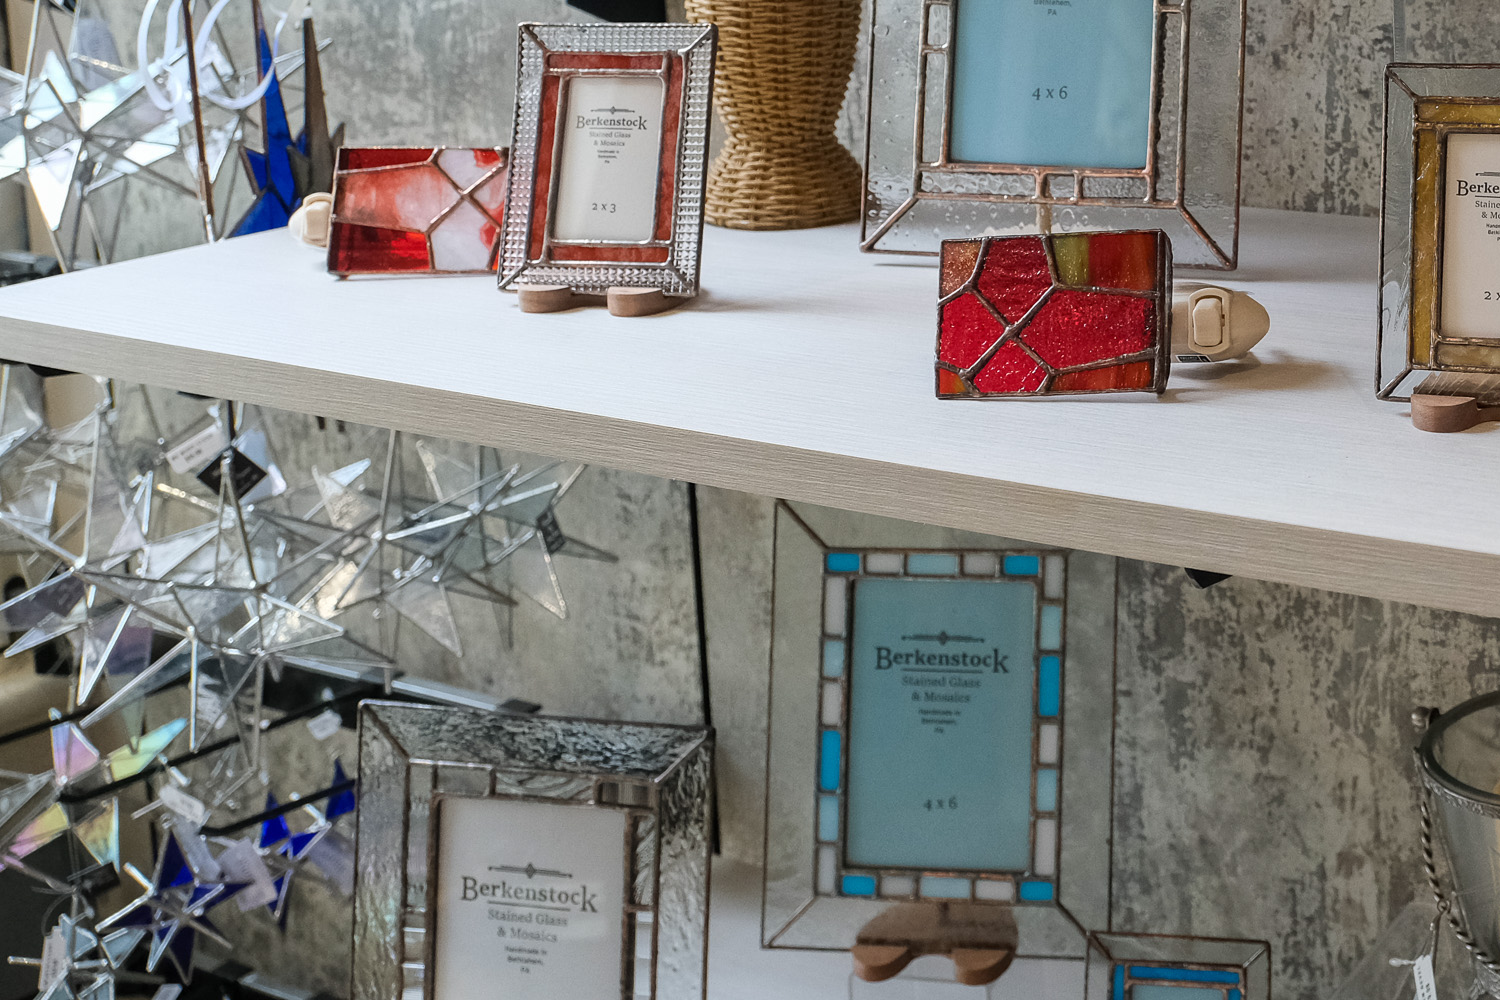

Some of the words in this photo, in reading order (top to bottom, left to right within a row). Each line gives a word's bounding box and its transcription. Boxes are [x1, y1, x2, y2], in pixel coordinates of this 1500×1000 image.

[1032, 88, 1041, 100] 4
[1046, 88, 1054, 99] x
[1059, 86, 1068, 99] 6
[576, 115, 647, 130] Berkenstock
[592, 203, 598, 211] 2
[601, 203, 607, 211] x
[610, 203, 616, 213] 3
[1484, 291, 1492, 300] 2
[875, 646, 1010, 674] Berkenstock
[461, 876, 598, 913] Berkenstock
